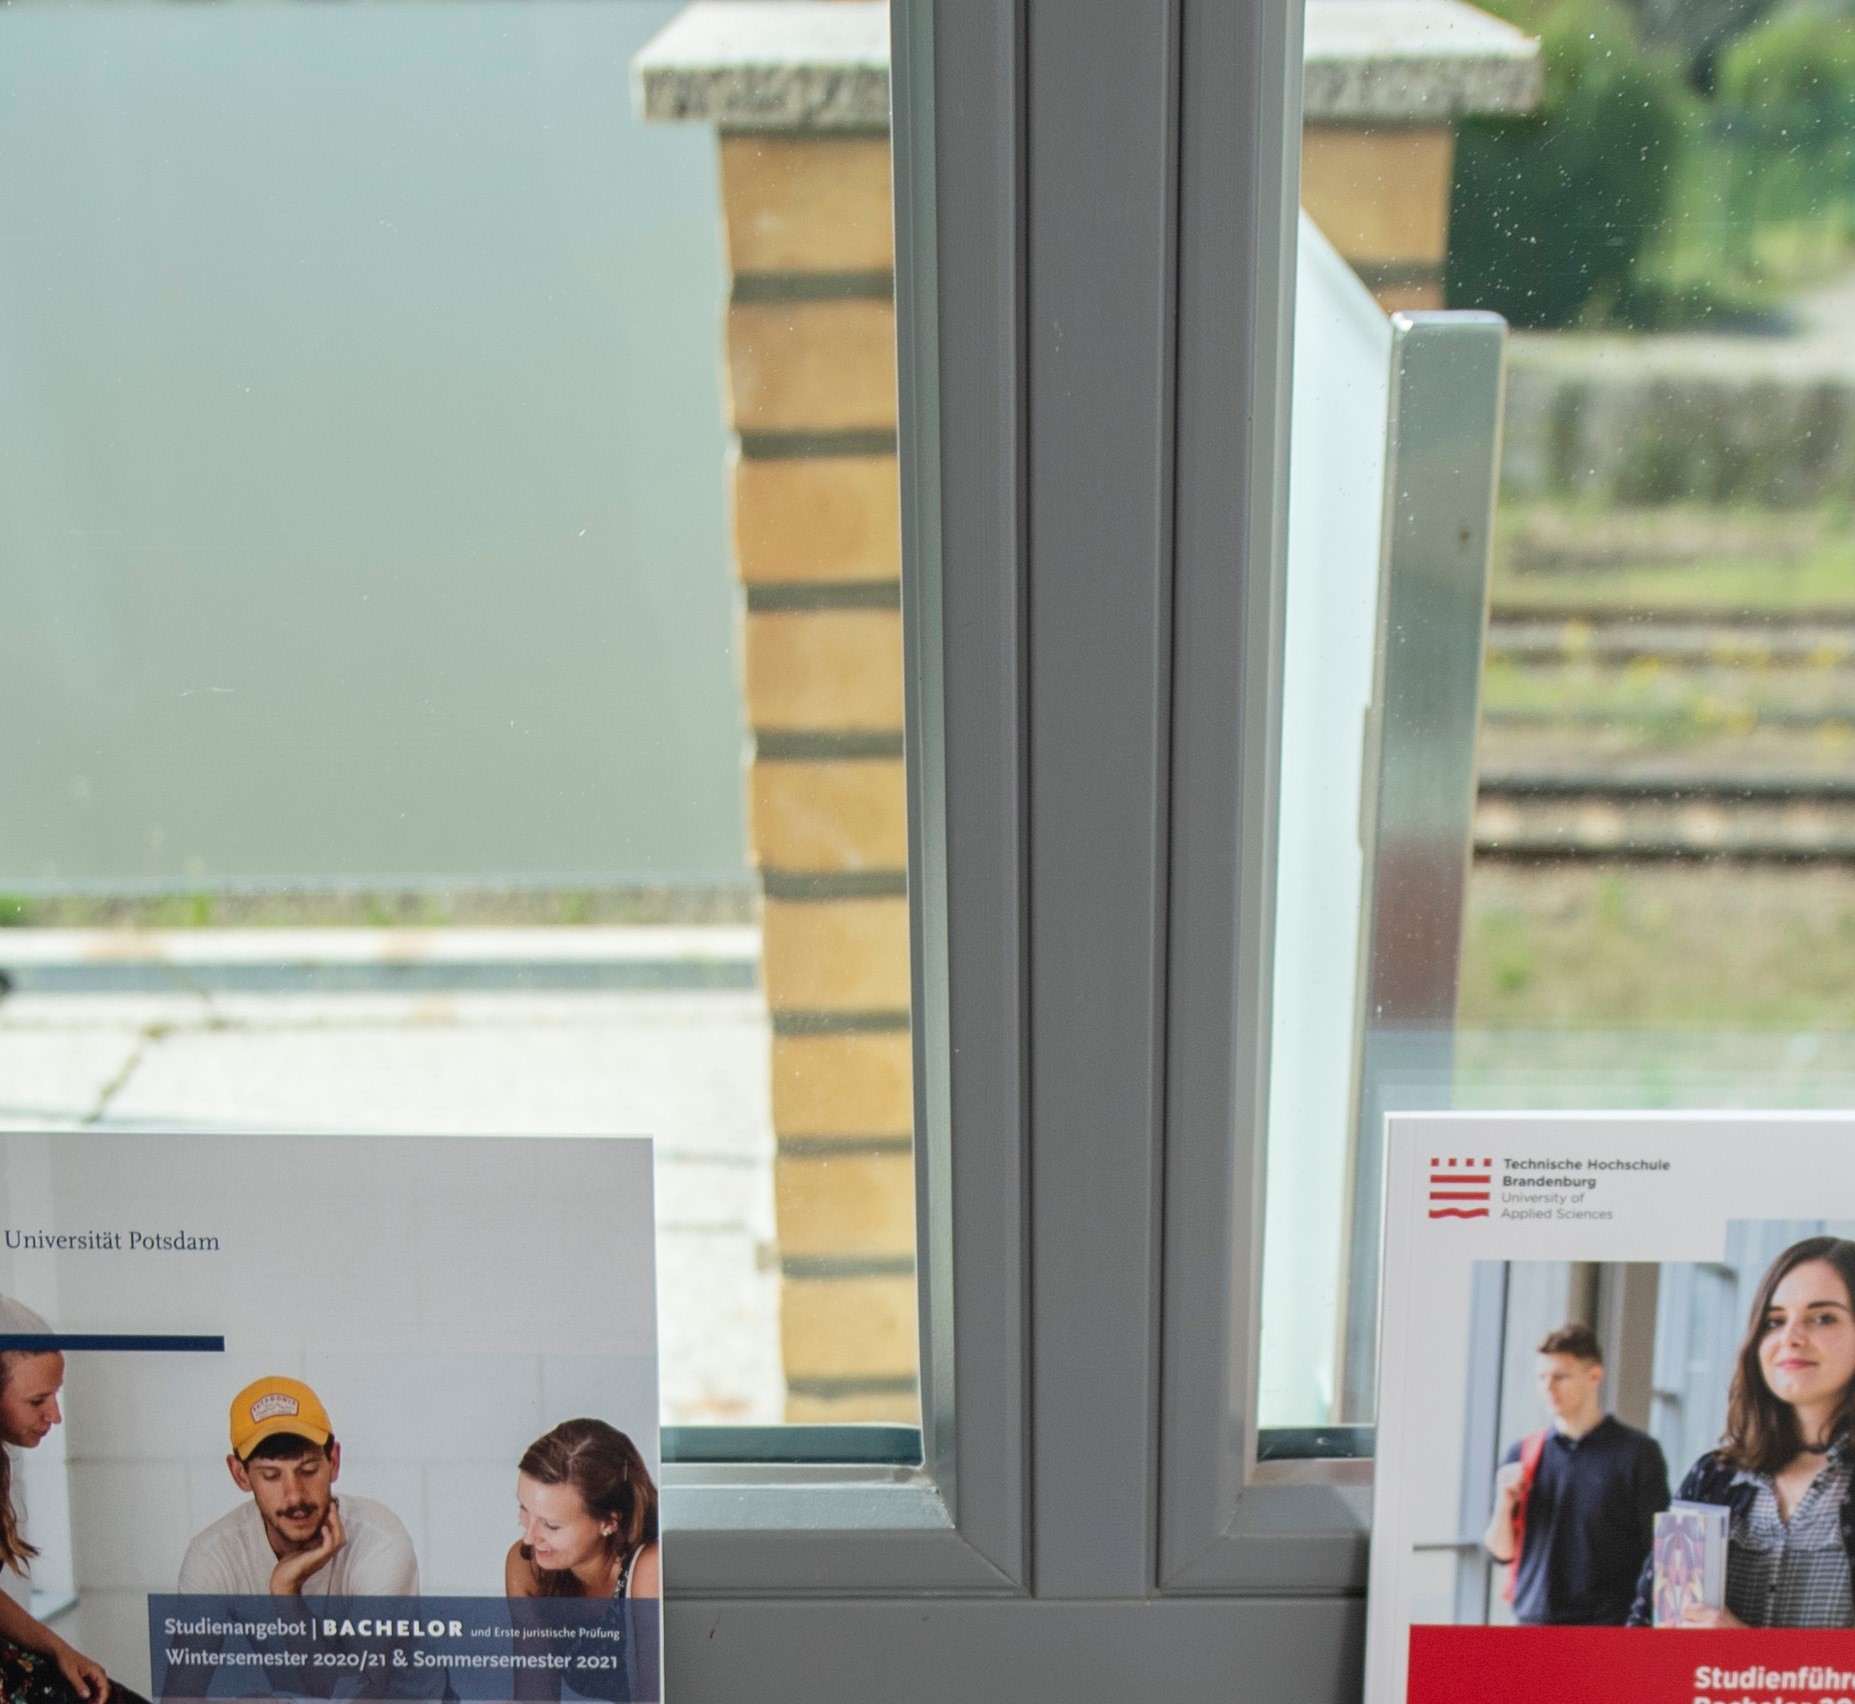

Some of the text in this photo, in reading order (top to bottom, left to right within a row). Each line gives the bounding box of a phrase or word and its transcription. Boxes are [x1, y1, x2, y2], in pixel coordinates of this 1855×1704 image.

[1504, 1158, 1670, 1170] Technische Hochschule
[1502, 1176, 1596, 1189] Brandenburg
[1502, 1193, 1584, 1205] University of
[1501, 1209, 1613, 1220] Applied Sciences
[5, 1230, 219, 1250] Universität Potsdam
[165, 1617, 620, 1641] Studienangebot BACHELOR und Erste juristische Prüfung
[165, 1649, 617, 1671] Wintersemester 2020/21 & Sommersemester 2021
